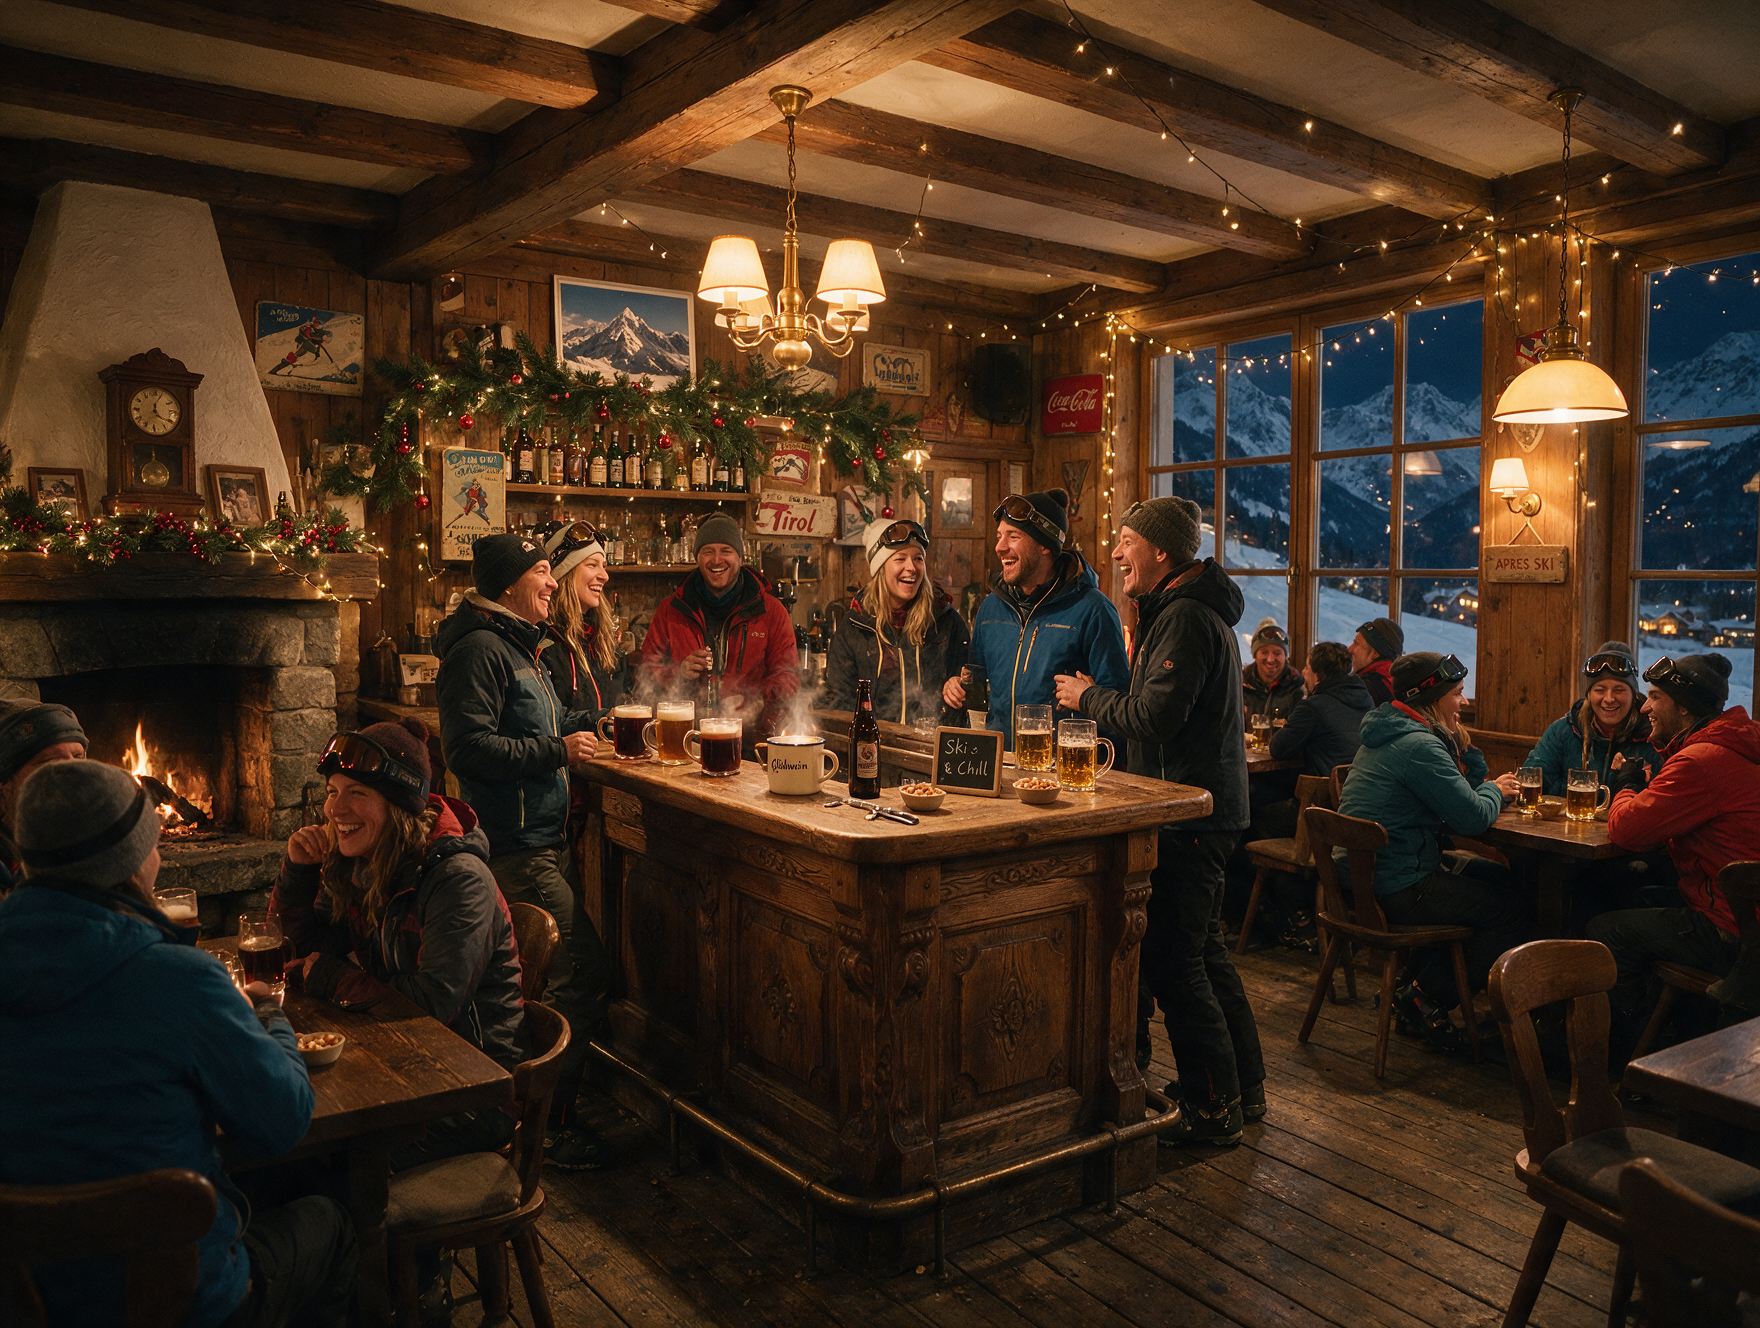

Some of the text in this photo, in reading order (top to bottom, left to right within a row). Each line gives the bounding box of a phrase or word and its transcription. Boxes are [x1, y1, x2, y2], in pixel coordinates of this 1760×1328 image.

[760, 502, 817, 533] Tirol
[1495, 557, 1554, 571] APRES SKI
[945, 737, 968, 754] Ski
[957, 760, 988, 776] Chill
